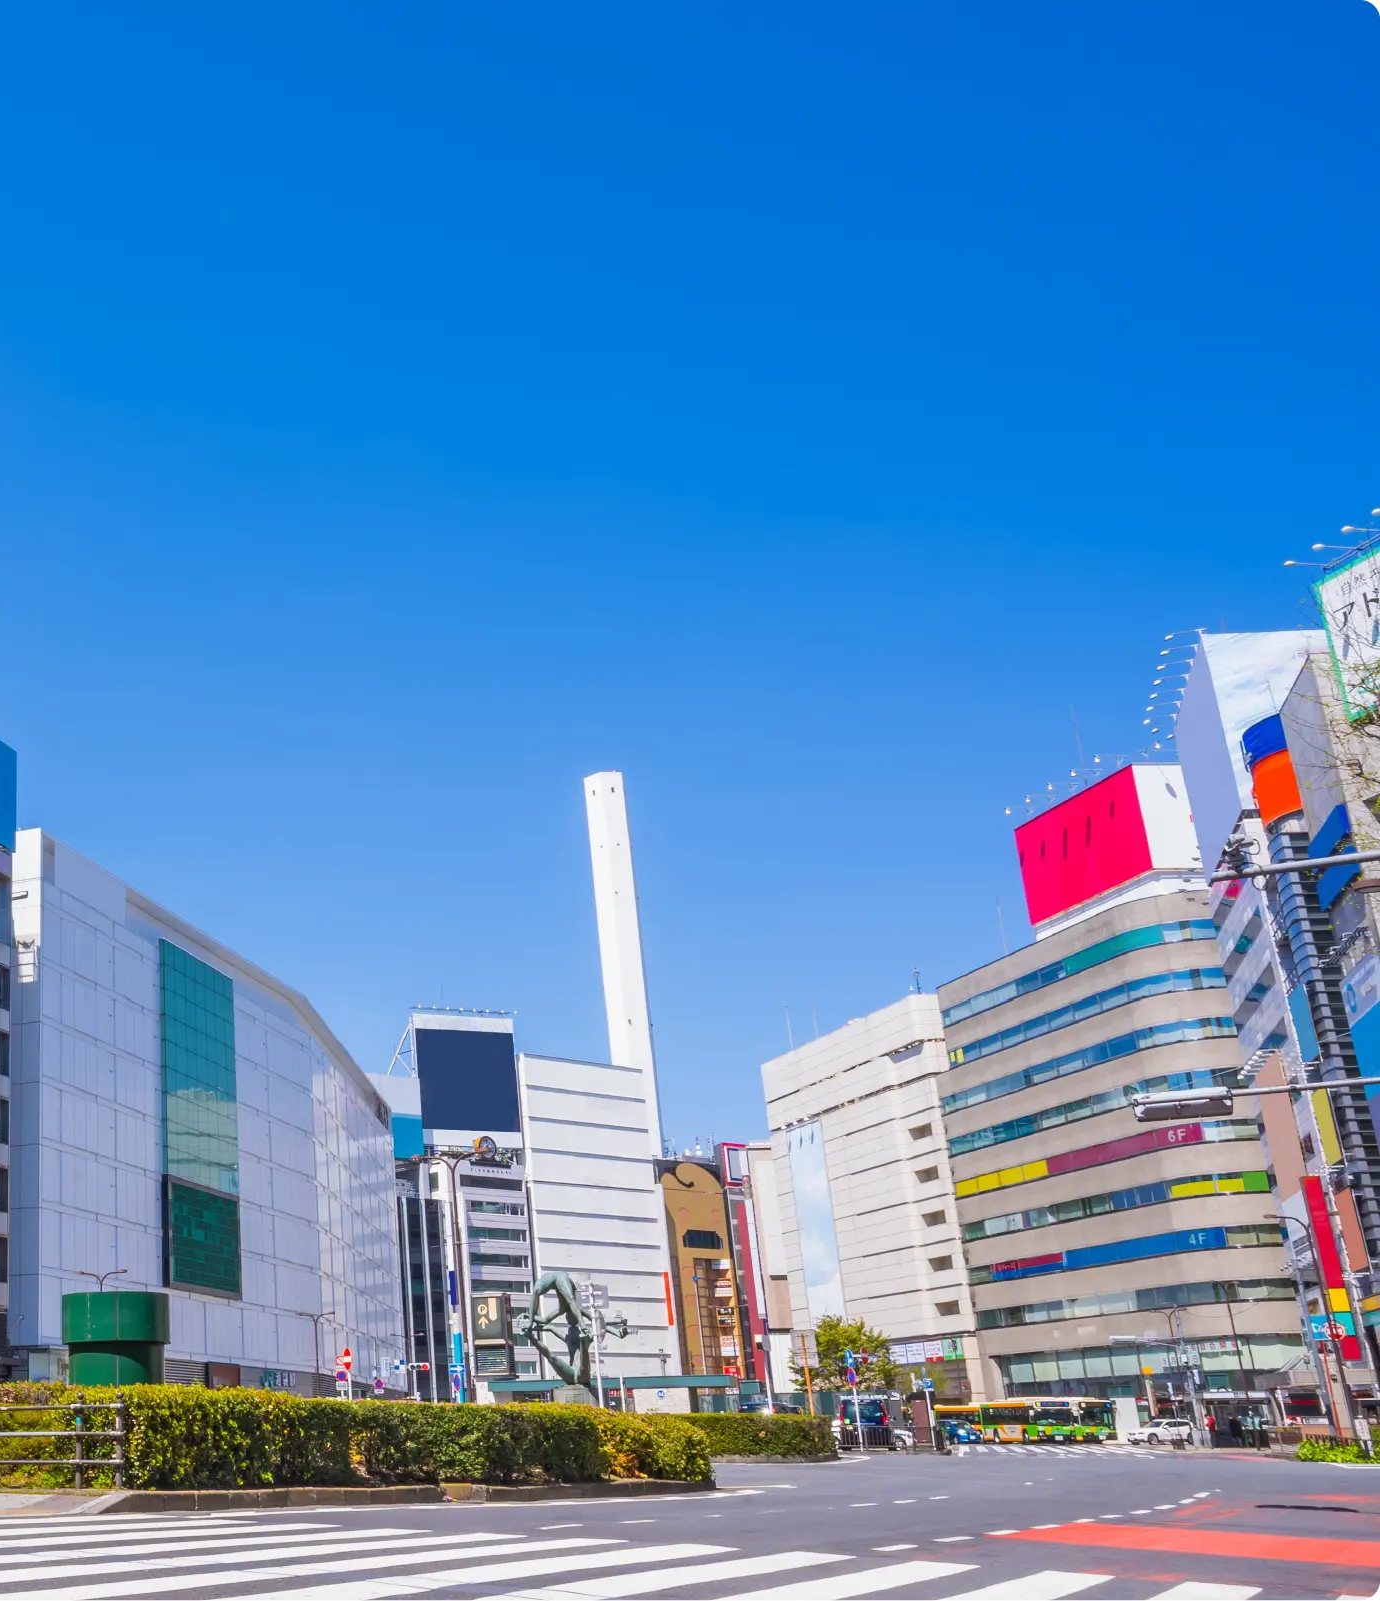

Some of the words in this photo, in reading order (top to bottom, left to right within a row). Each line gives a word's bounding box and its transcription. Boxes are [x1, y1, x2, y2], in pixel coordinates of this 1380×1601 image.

[1168, 1128, 1186, 1142] 6F
[1188, 1232, 1207, 1246] 4F
[479, 1305, 487, 1315] P
